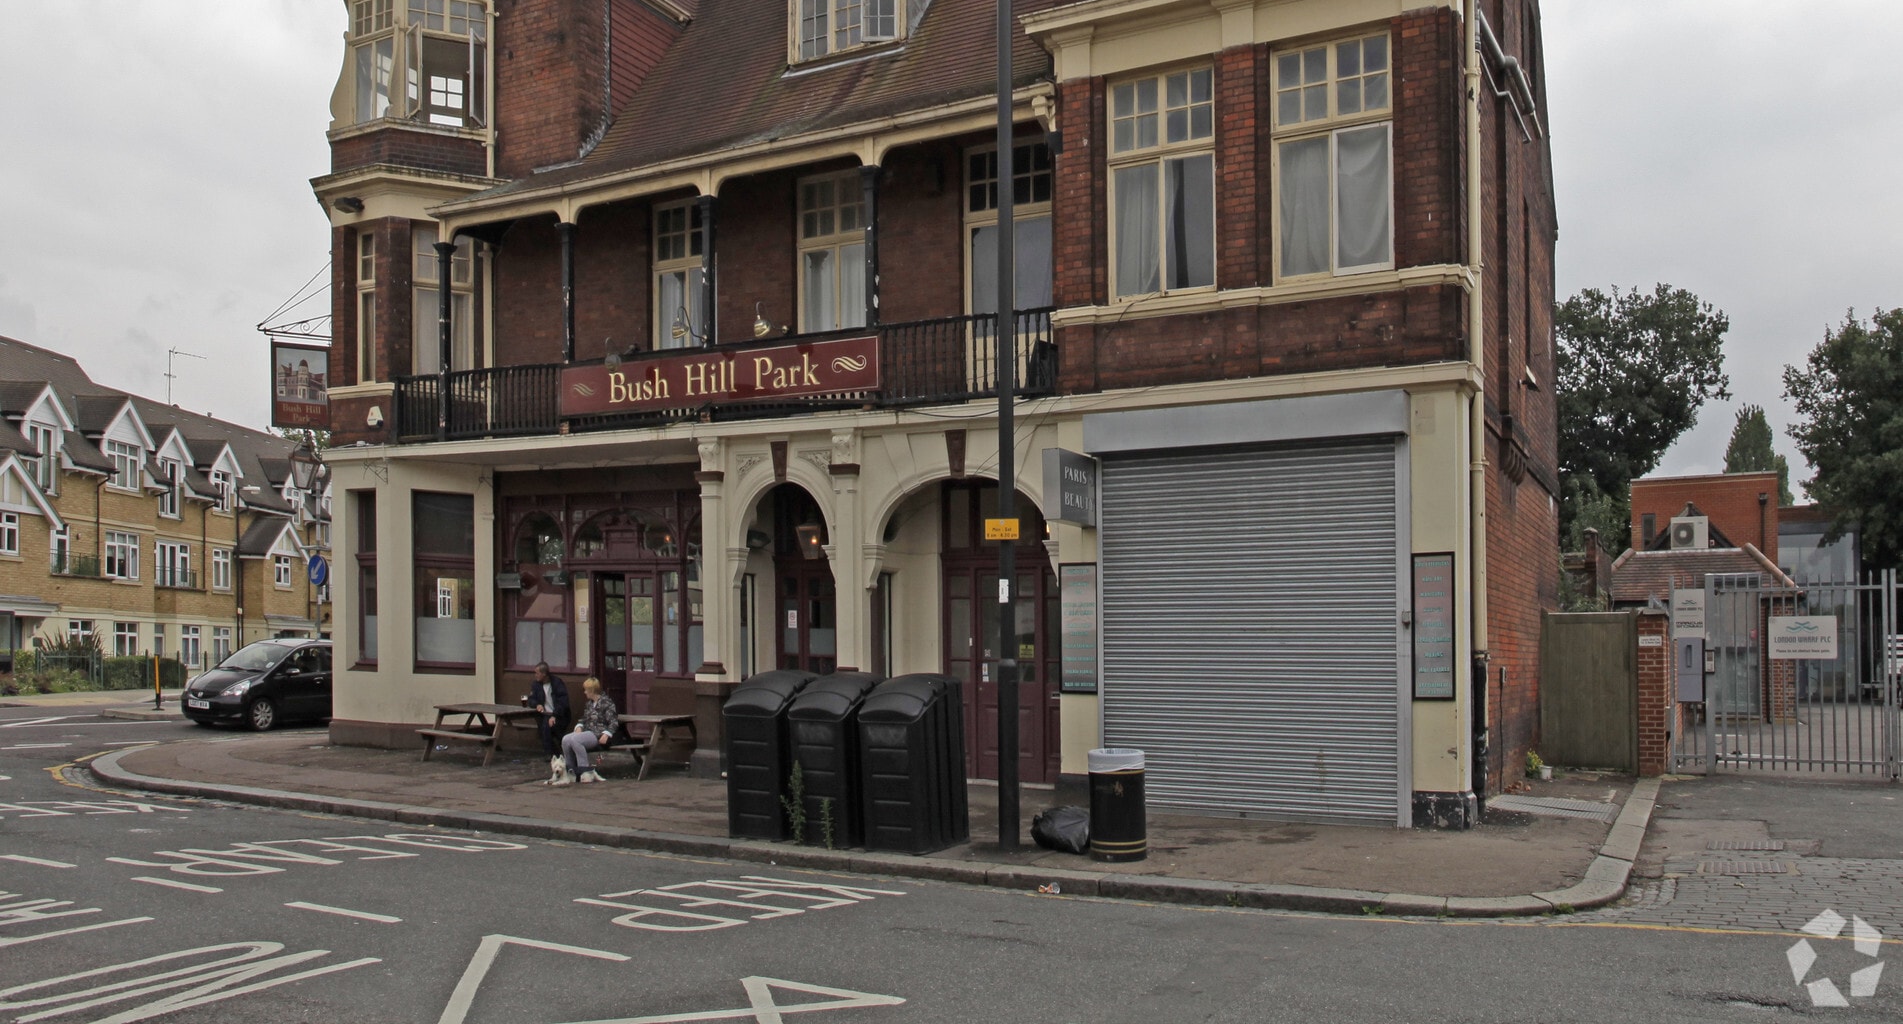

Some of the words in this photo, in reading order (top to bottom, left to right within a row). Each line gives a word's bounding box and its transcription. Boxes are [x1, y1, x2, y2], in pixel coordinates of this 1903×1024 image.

[608, 367, 670, 403] Bush
[684, 359, 738, 396] Hill
[753, 352, 820, 390] Park
[282, 403, 302, 413] Bush
[305, 405, 321, 414] Hill
[292, 412, 310, 422] Park
[1064, 465, 1088, 484] PARIS
[1774, 636, 1796, 644] LONDON
[1820, 636, 1831, 644] PLC
[105, 834, 528, 876] CLEAR
[573, 876, 907, 932] KEEP
